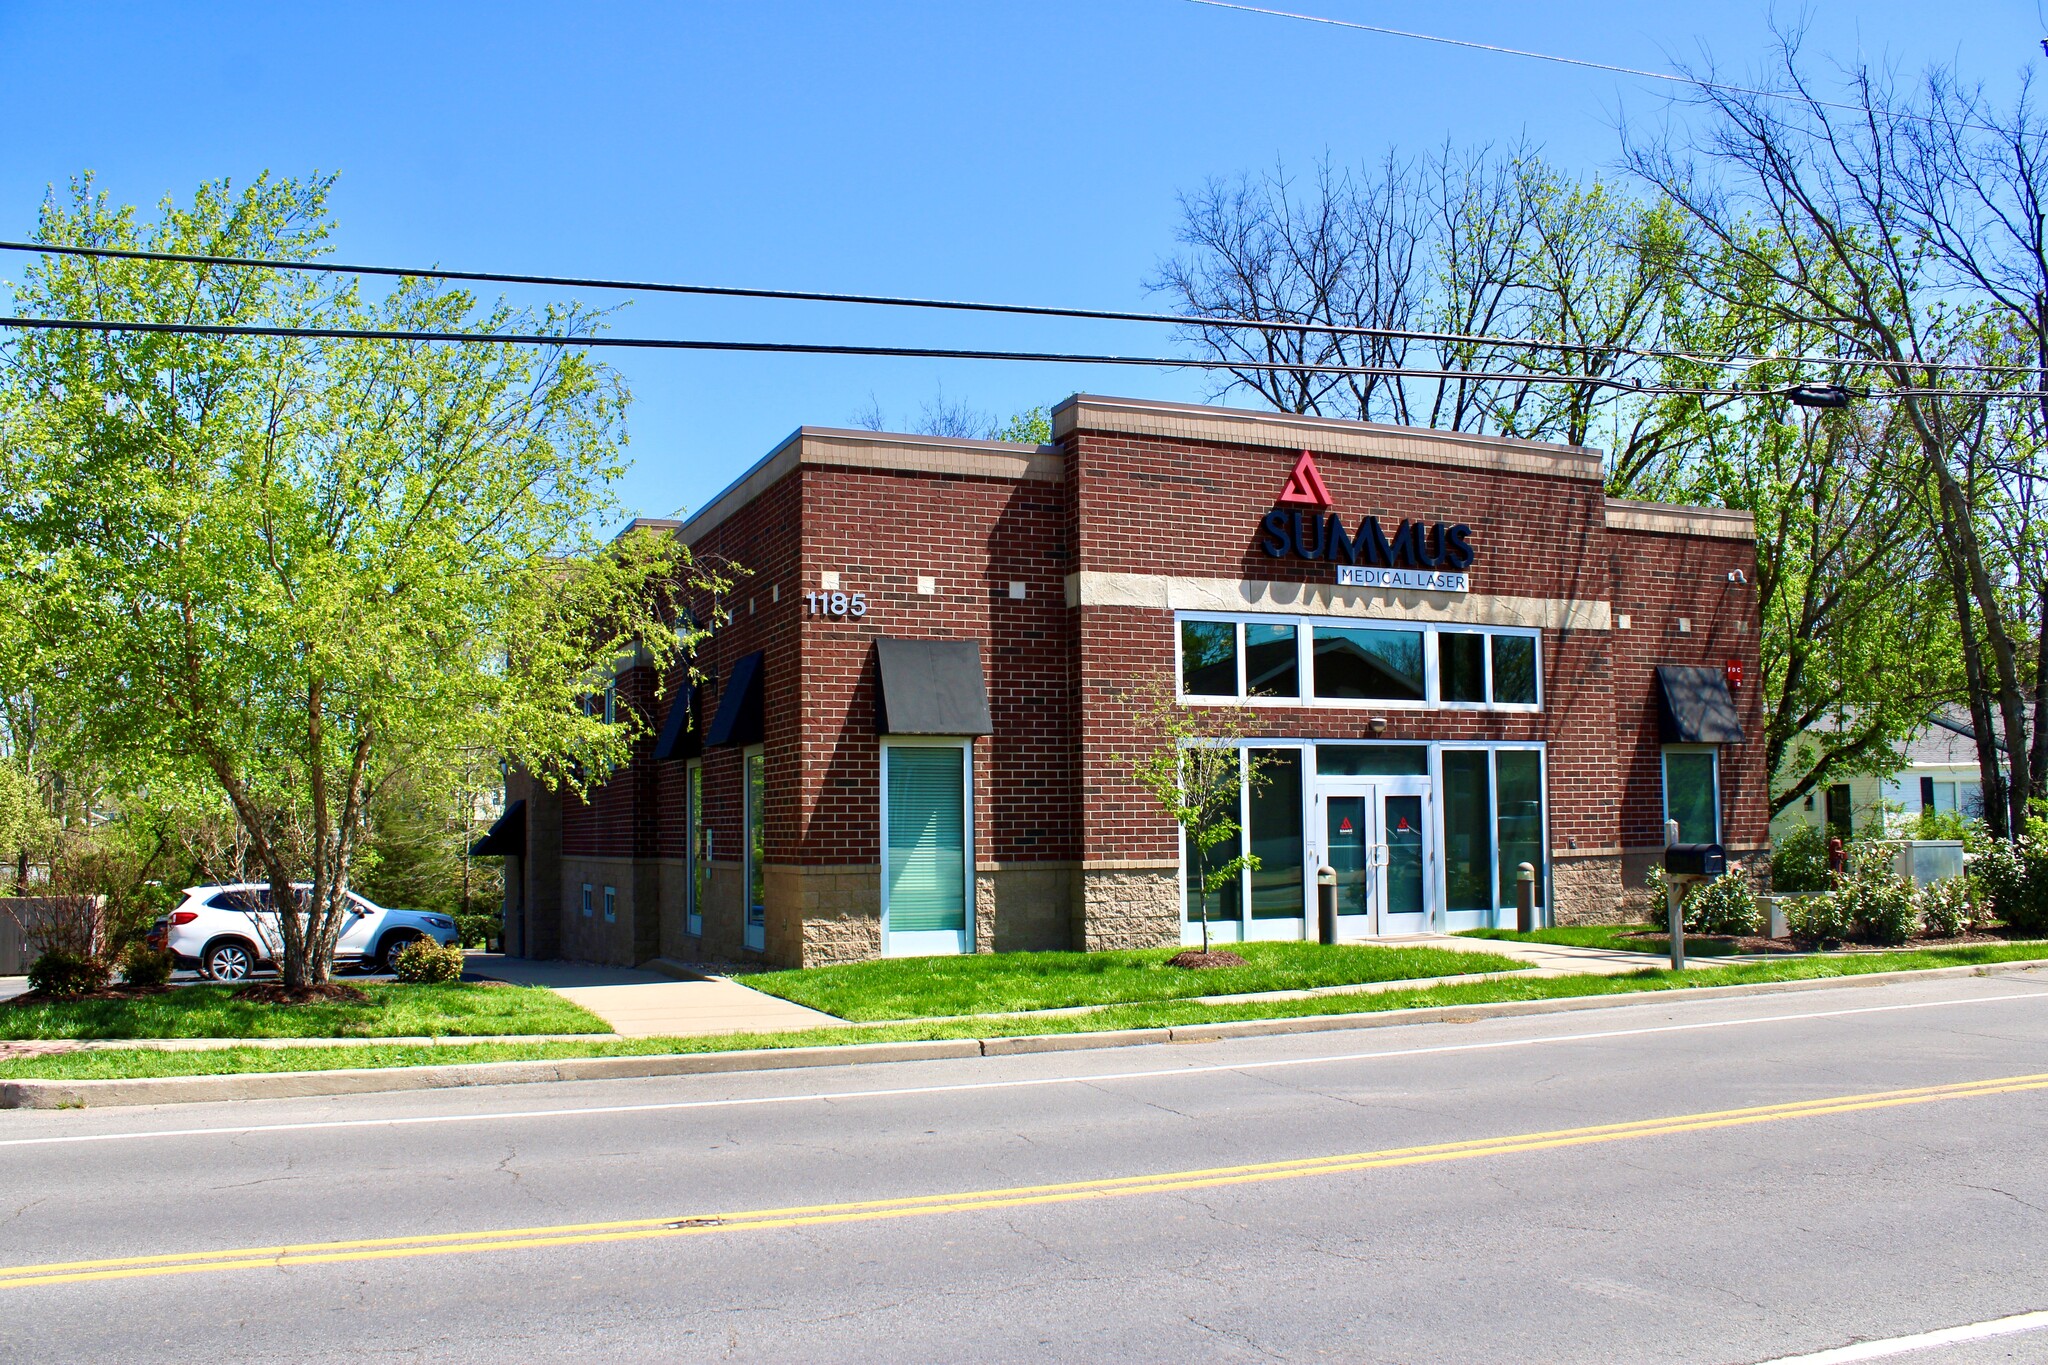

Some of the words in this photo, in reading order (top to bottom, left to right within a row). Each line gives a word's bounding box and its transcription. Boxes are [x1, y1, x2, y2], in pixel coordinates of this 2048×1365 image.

[1262, 509, 1474, 569] SUMMUS
[1342, 568, 1411, 585] MEDICAL
[1418, 573, 1465, 589] LASER
[806, 591, 867, 616] 1185
